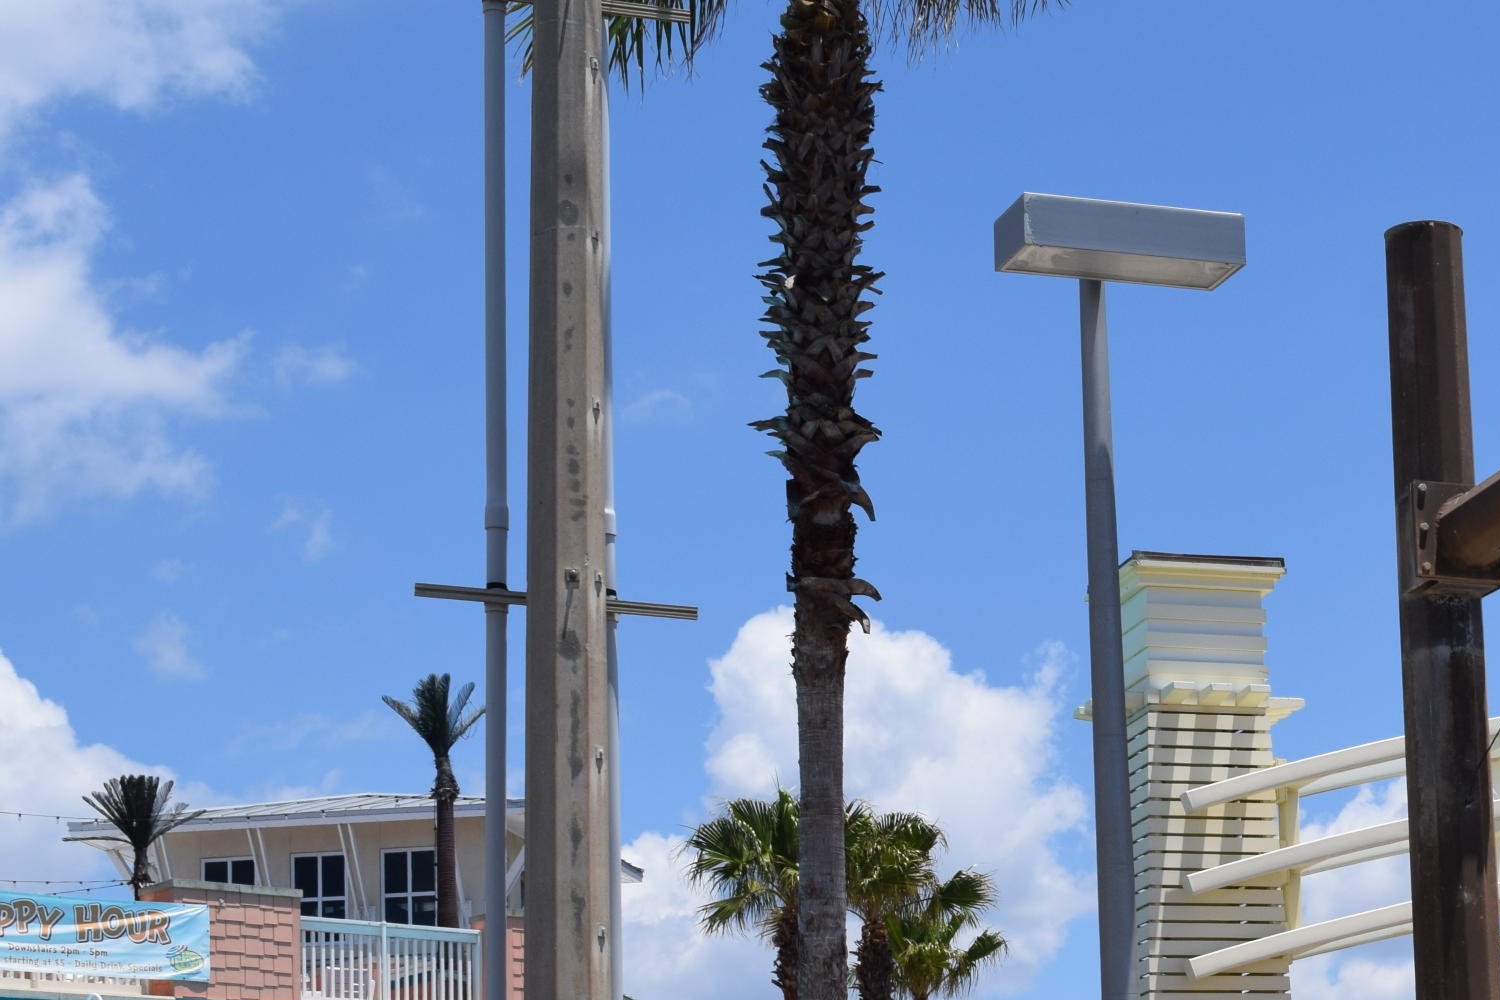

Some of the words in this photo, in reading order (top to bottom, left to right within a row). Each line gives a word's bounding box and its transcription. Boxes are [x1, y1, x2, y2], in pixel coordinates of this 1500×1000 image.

[73, 903, 171, 945] HOUR
[8, 943, 57, 954] Downstairs
[60, 945, 80, 957] 2pm
[89, 947, 108, 958] 5pm
